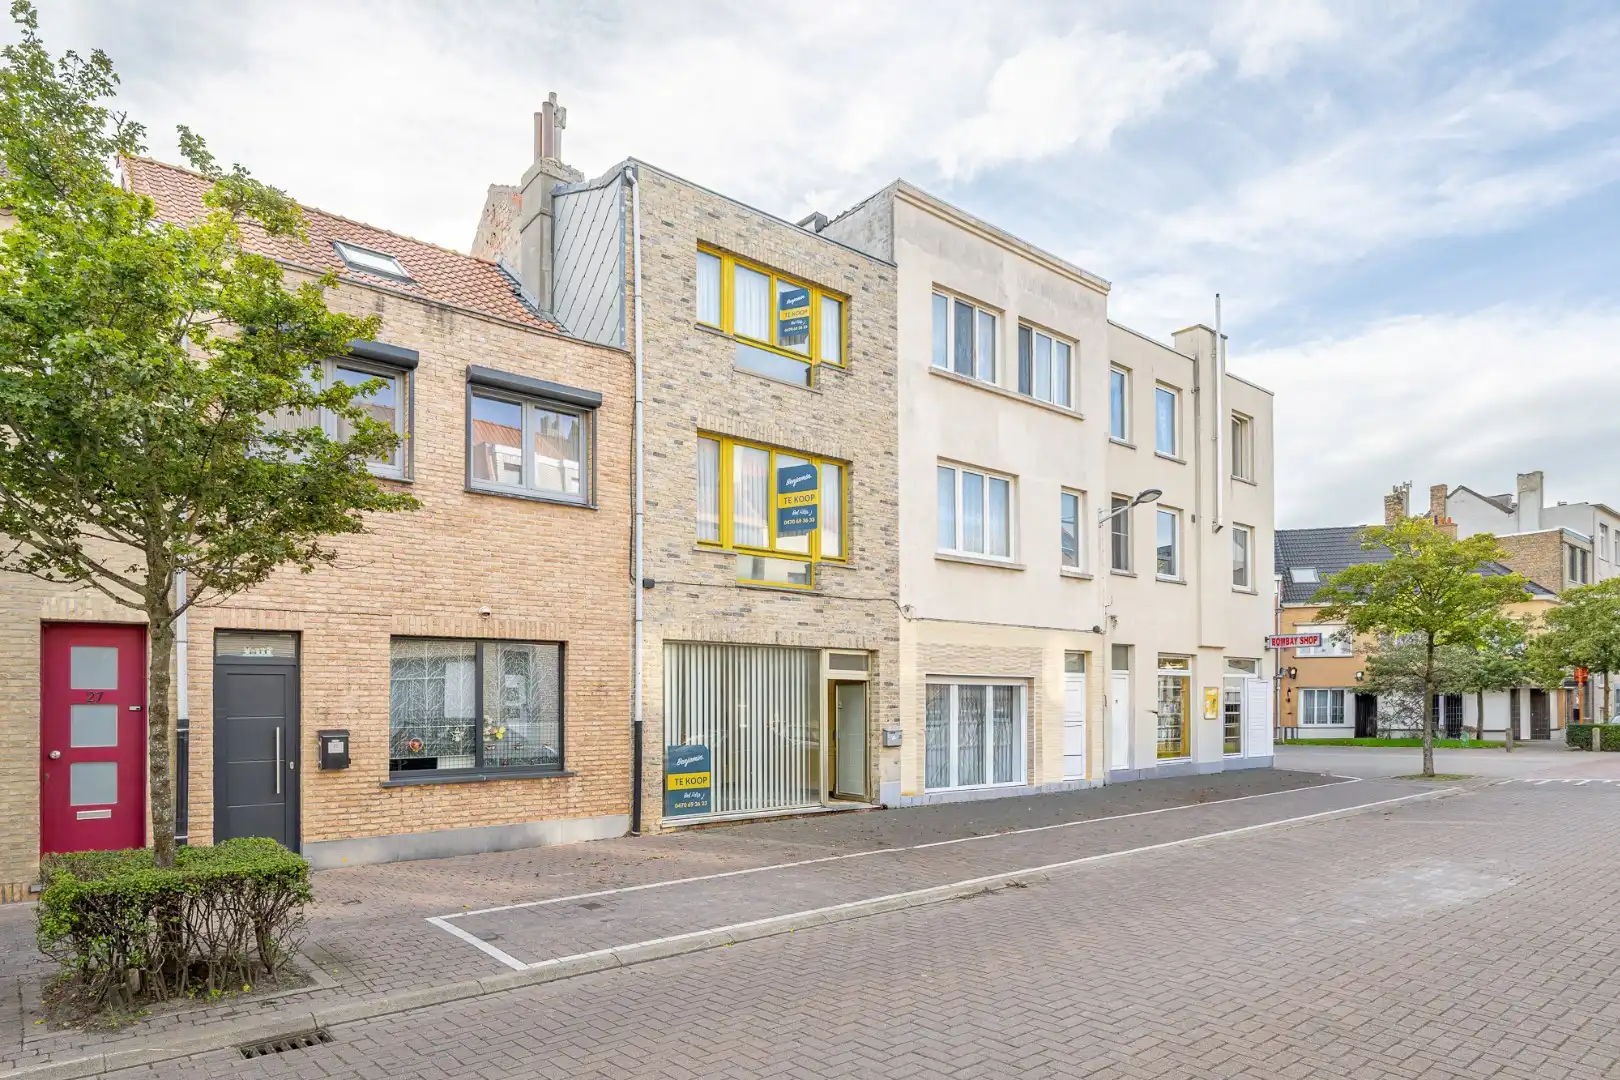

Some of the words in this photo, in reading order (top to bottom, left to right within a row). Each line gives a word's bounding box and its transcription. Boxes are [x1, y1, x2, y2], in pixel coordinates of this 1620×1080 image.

[784, 497, 792, 505] TE
[794, 494, 815, 503] KOOP
[1299, 635, 1318, 645] SHOP
[87, 691, 104, 703] 27
[674, 778, 684, 786] TE
[685, 776, 708, 785] KOOP
